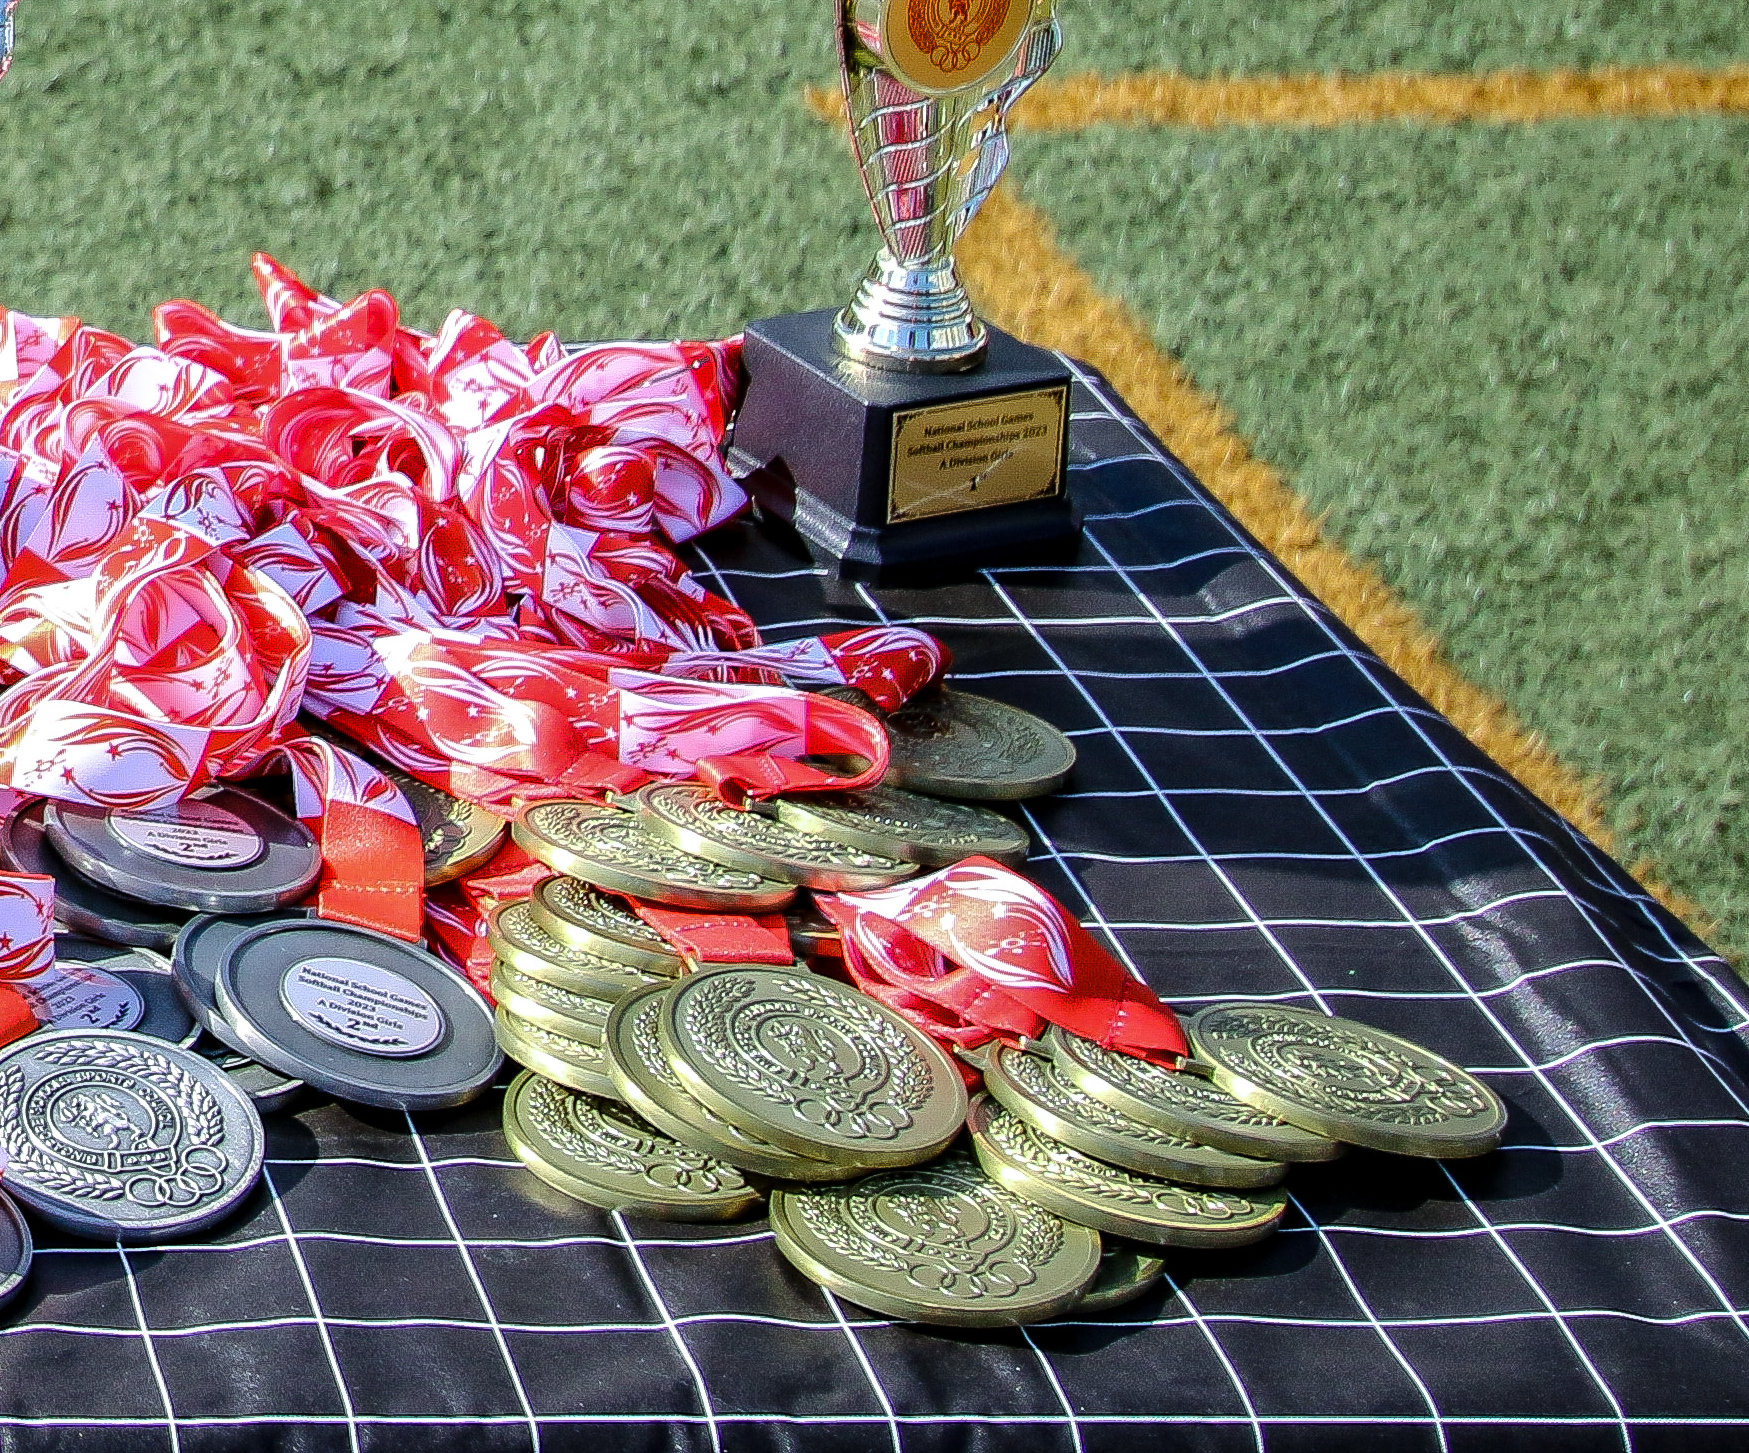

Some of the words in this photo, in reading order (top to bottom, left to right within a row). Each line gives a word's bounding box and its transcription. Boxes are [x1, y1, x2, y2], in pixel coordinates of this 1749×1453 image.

[298, 975, 341, 992] Softball
[342, 988, 428, 1020] Championships
[302, 966, 349, 986] National
[352, 982, 389, 997] School
[390, 993, 428, 1010] Games
[317, 999, 327, 1007] A
[328, 1002, 374, 1020] Division
[376, 1016, 404, 1030] Girls
[347, 999, 376, 1012] 2023
[346, 1018, 379, 1031] 2nd
